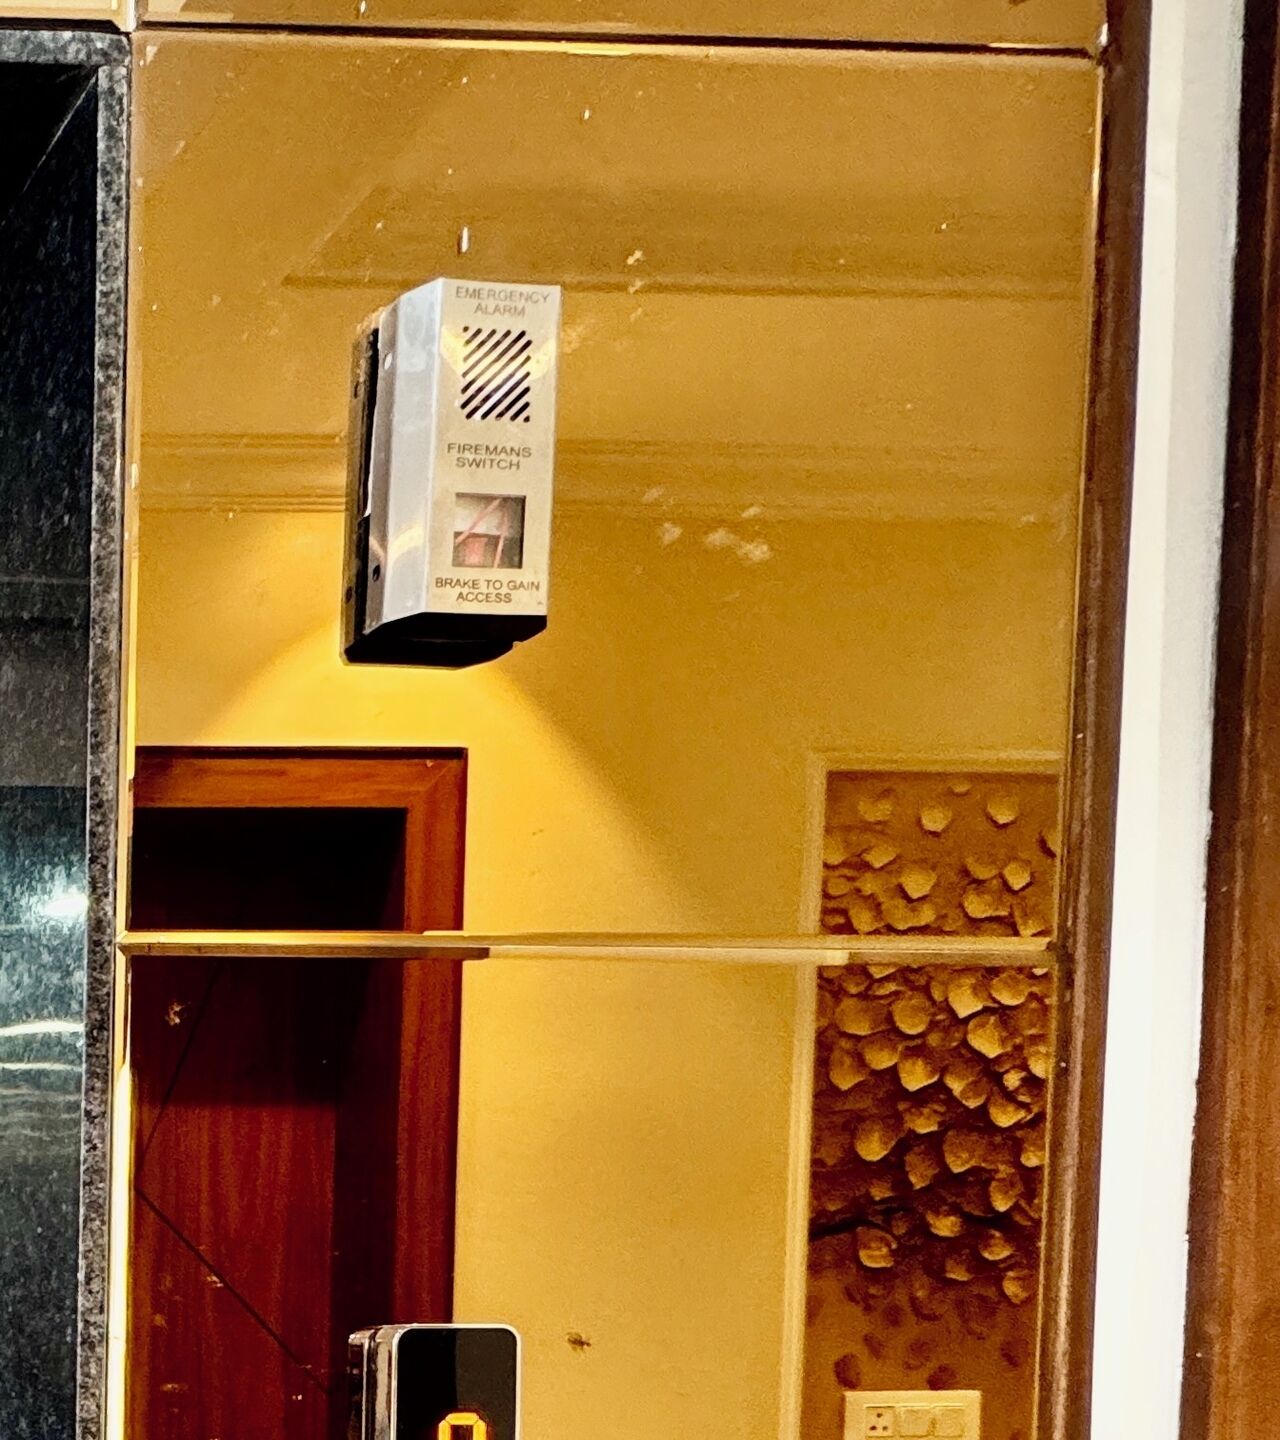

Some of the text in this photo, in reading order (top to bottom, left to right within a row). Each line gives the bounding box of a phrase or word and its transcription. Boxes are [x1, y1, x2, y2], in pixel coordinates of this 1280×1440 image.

[455, 285, 550, 304] EMERGENCY
[473, 303, 525, 317] ALARM
[447, 442, 532, 458] FIREMANS
[455, 456, 520, 471] SWITCH
[435, 576, 541, 592] BRAKE TO GAIN
[456, 591, 512, 604] ACCESS
